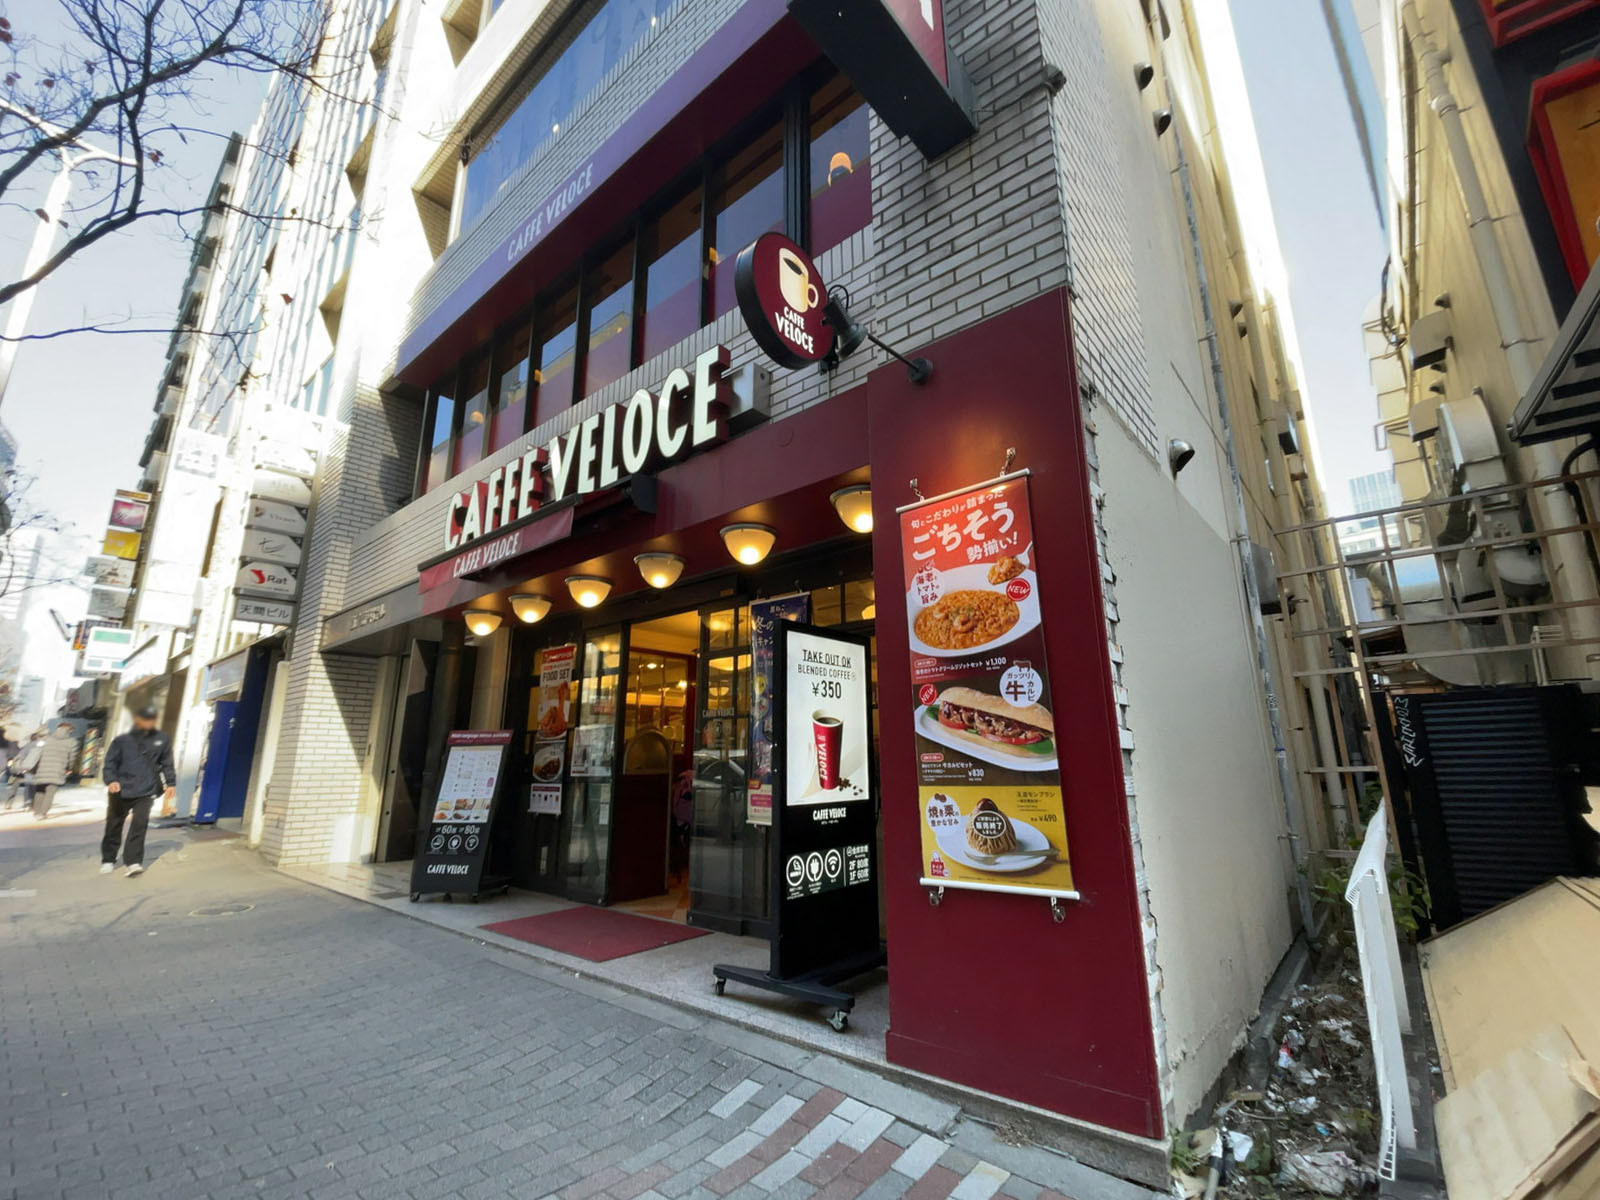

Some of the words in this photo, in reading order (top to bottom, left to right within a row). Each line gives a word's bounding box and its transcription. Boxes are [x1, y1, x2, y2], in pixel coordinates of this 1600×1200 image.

[506, 214, 544, 264] CAFFE
[546, 161, 595, 233] VELOCE
[783, 306, 806, 329] CAFFE
[774, 312, 815, 355] VELOCE
[445, 448, 541, 551] CAFFE
[550, 345, 720, 501] VELOCE
[912, 501, 1015, 560] ごちそう
[452, 547, 481, 579] CAFFE
[482, 531, 520, 564] VELOCE
[267, 574, 289, 586] Rat
[1007, 583, 1030, 595] NEW
[802, 649, 823, 664] TAKE
[824, 653, 840, 667] OUT
[841, 656, 852, 668] OK
[543, 670, 558, 683] FOOD
[558, 668, 570, 680] SET
[797, 664, 828, 677] BLENDED
[829, 668, 851, 681] COFFEE
[811, 680, 842, 699] ¥350
[921, 686, 935, 704] NEW
[1005, 680, 1027, 702] 牛
[1027, 680, 1036, 702] カルビ
[968, 768, 985, 778] ¥830
[813, 809, 829, 822] CAFFE
[829, 808, 847, 820] VELOCE
[1039, 814, 1057, 823] ¥490
[427, 864, 447, 875] CAFFE
[446, 864, 470, 876] VELOCE
